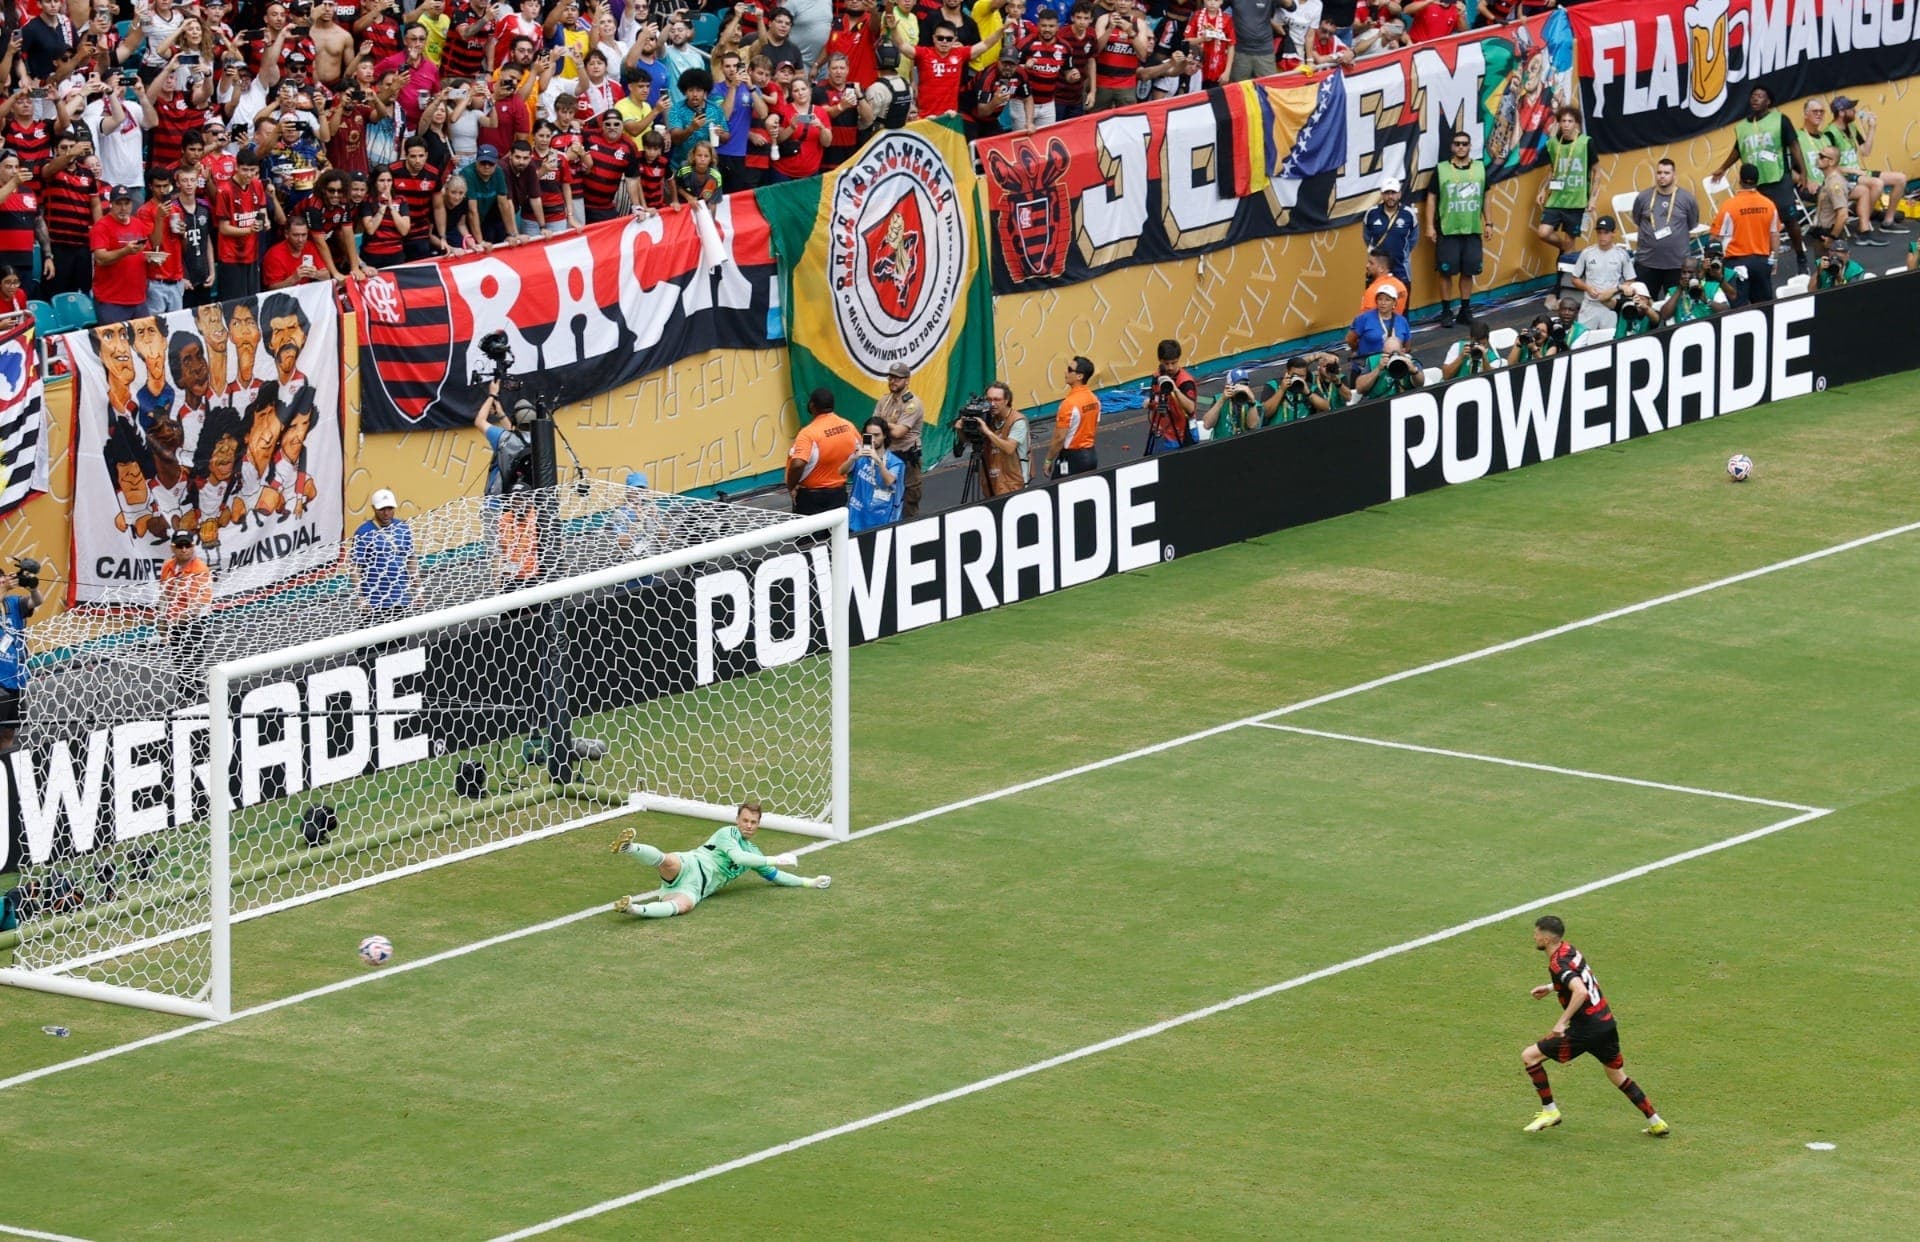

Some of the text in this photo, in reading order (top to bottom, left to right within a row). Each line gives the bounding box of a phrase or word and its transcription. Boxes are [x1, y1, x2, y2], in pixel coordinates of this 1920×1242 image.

[1076, 42, 1485, 268] JOEM
[1390, 295, 1815, 500] POWERADE
[227, 521, 321, 573] MUNDIAL
[694, 459, 1160, 685] POWERADE
[0, 646, 430, 874] WERADE
